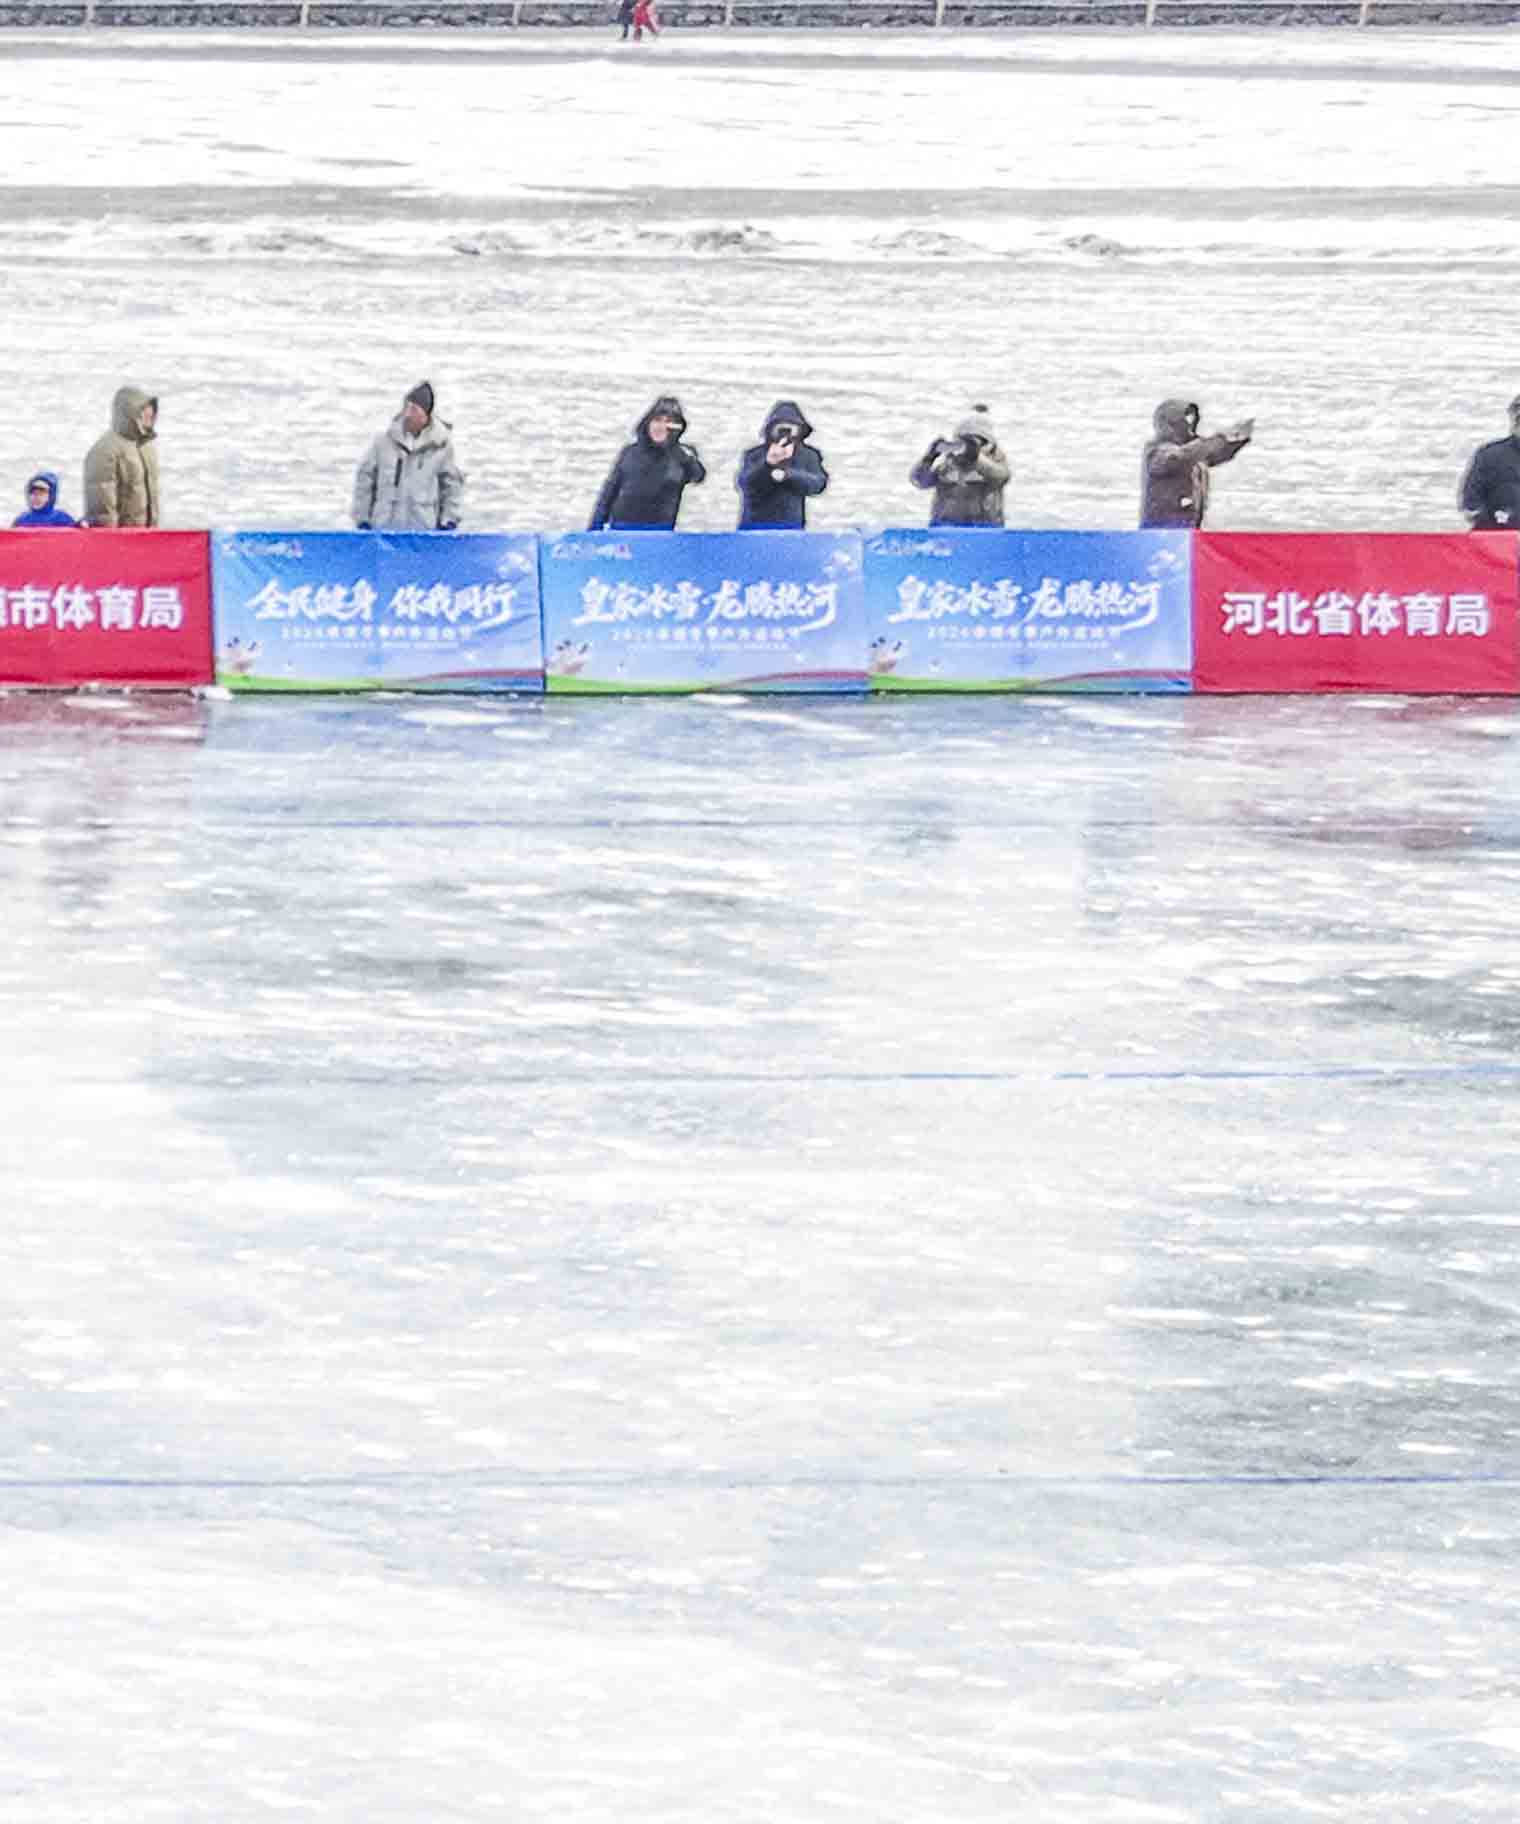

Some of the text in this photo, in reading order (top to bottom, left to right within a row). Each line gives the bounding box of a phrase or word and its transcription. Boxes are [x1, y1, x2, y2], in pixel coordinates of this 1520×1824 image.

[245, 578, 518, 630] 全民健身 你我同行
[1221, 591, 1489, 636] 河北省体育局
